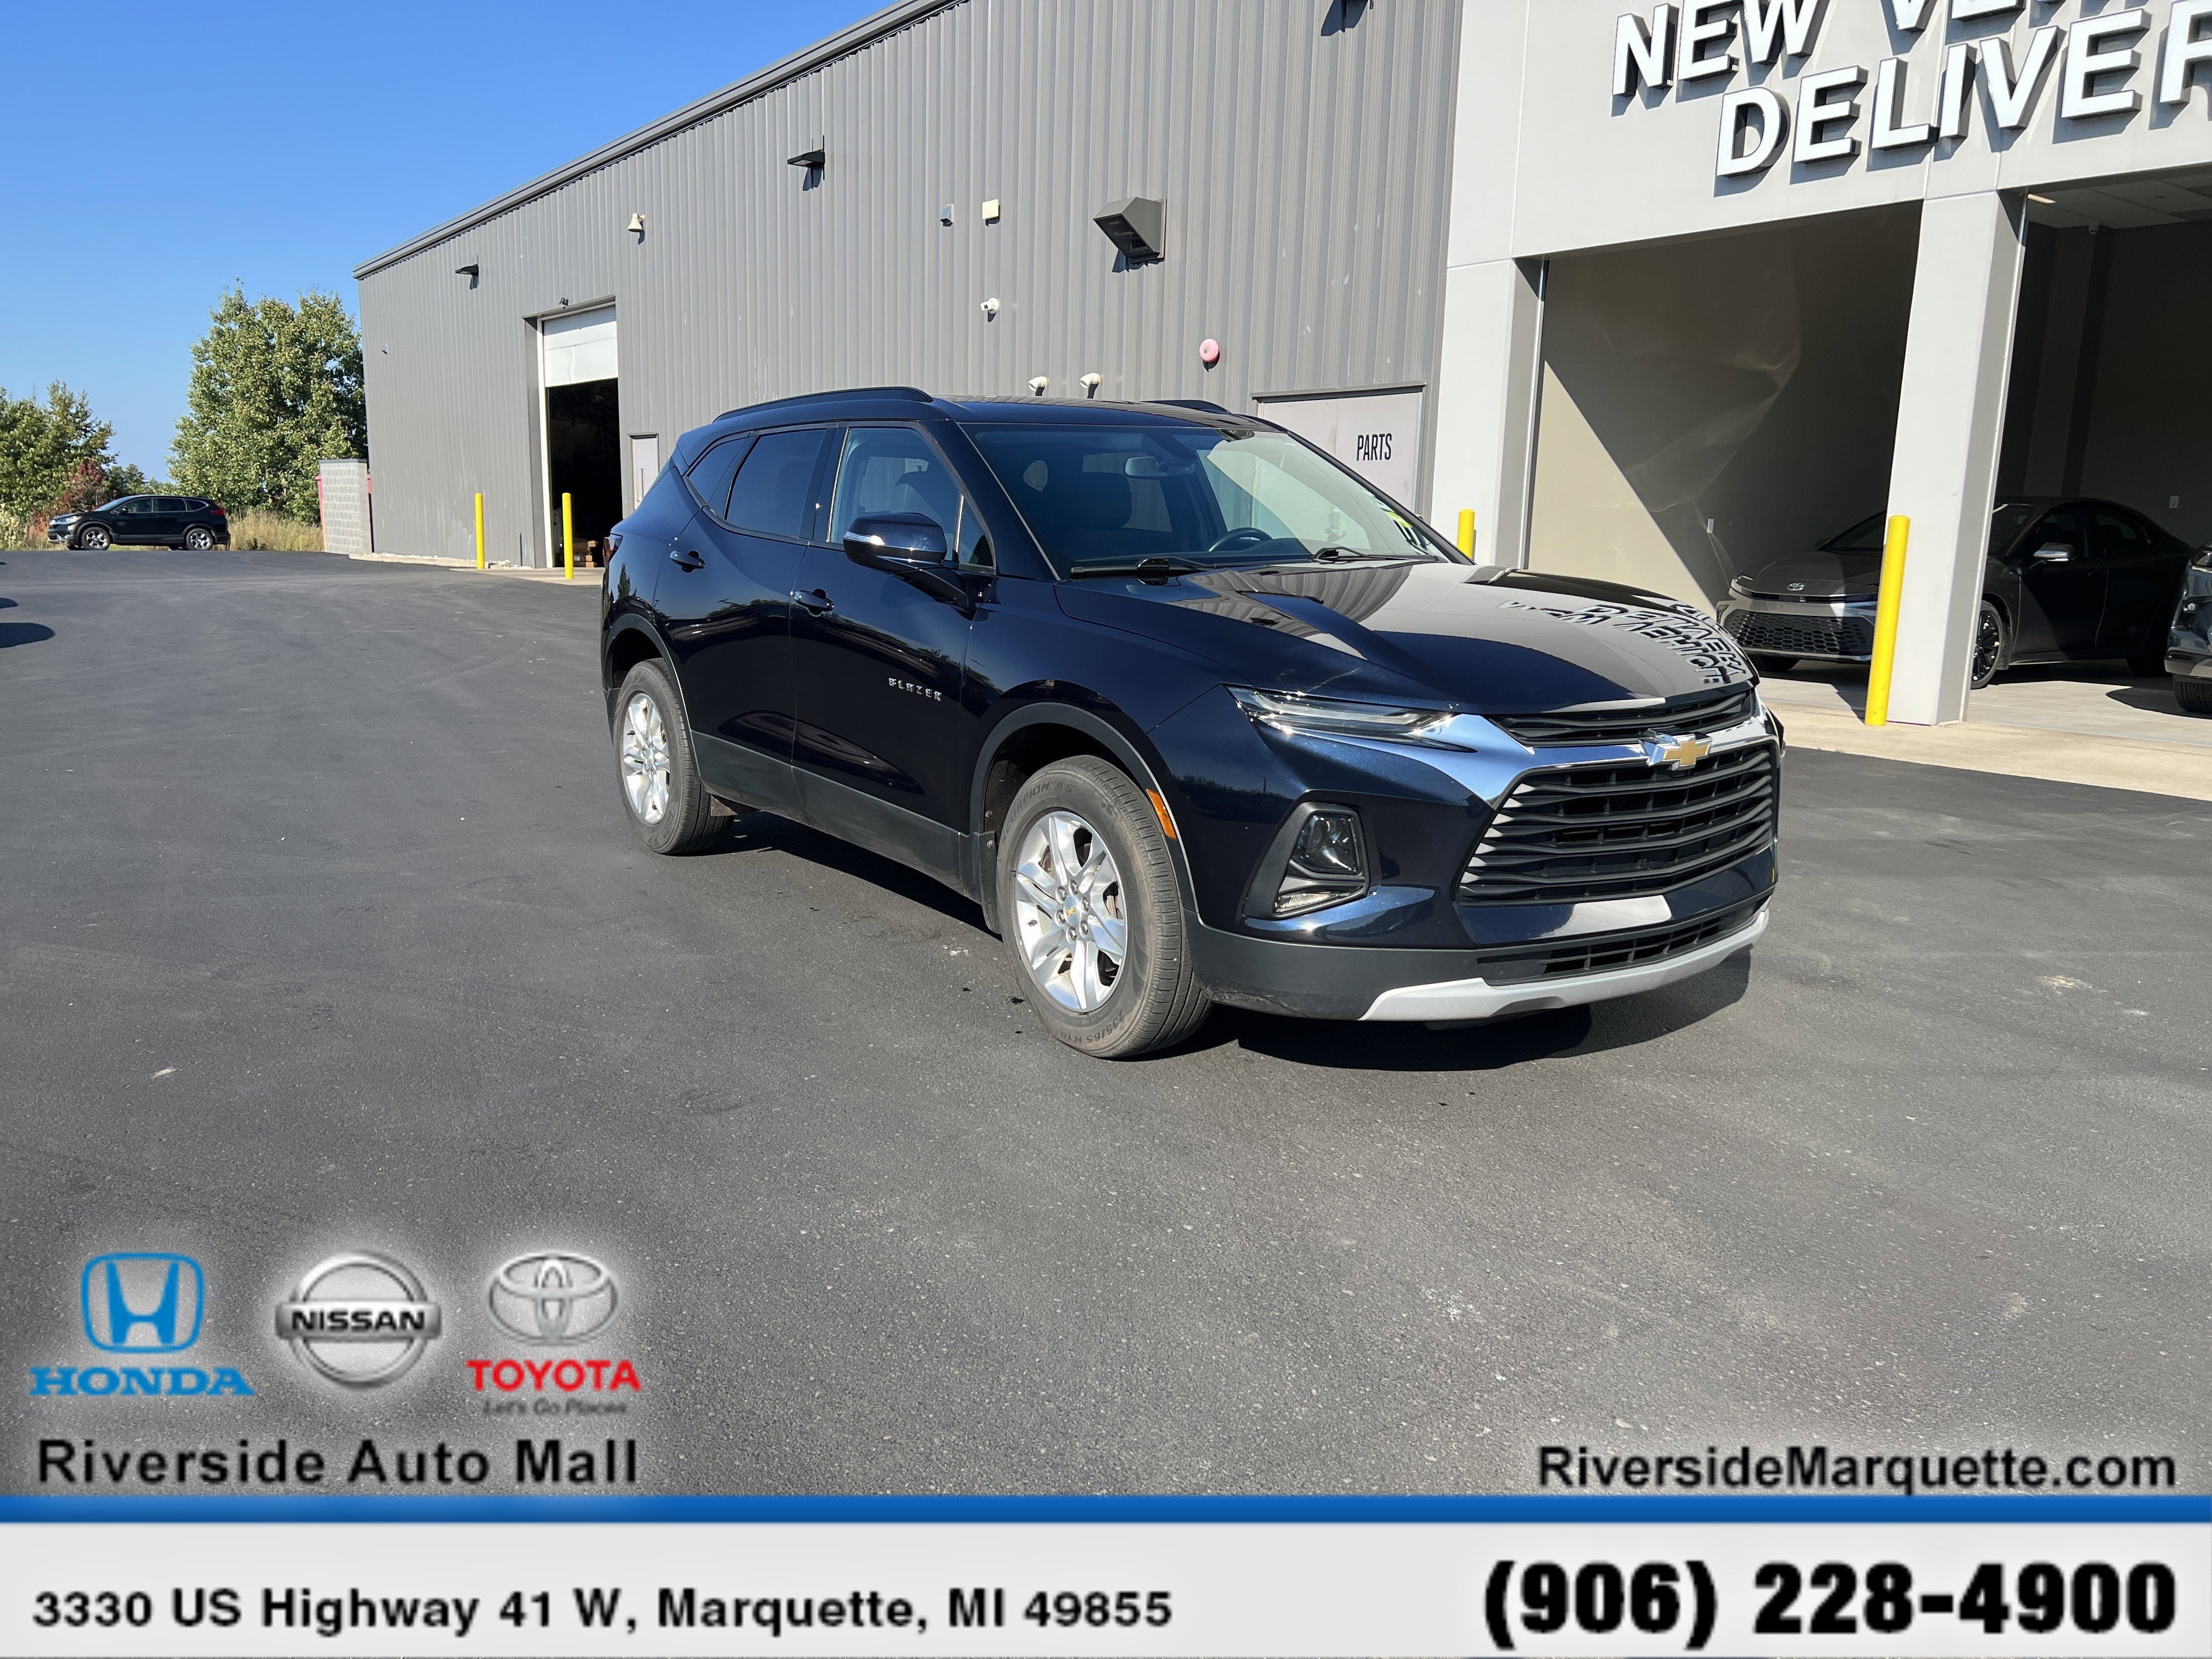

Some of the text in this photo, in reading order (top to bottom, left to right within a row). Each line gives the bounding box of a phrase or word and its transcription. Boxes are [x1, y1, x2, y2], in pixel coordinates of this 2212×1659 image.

[1611, 0, 1820, 97] NEW
[1356, 432, 1392, 461] PARTS
[888, 677, 943, 702] BLAZER
